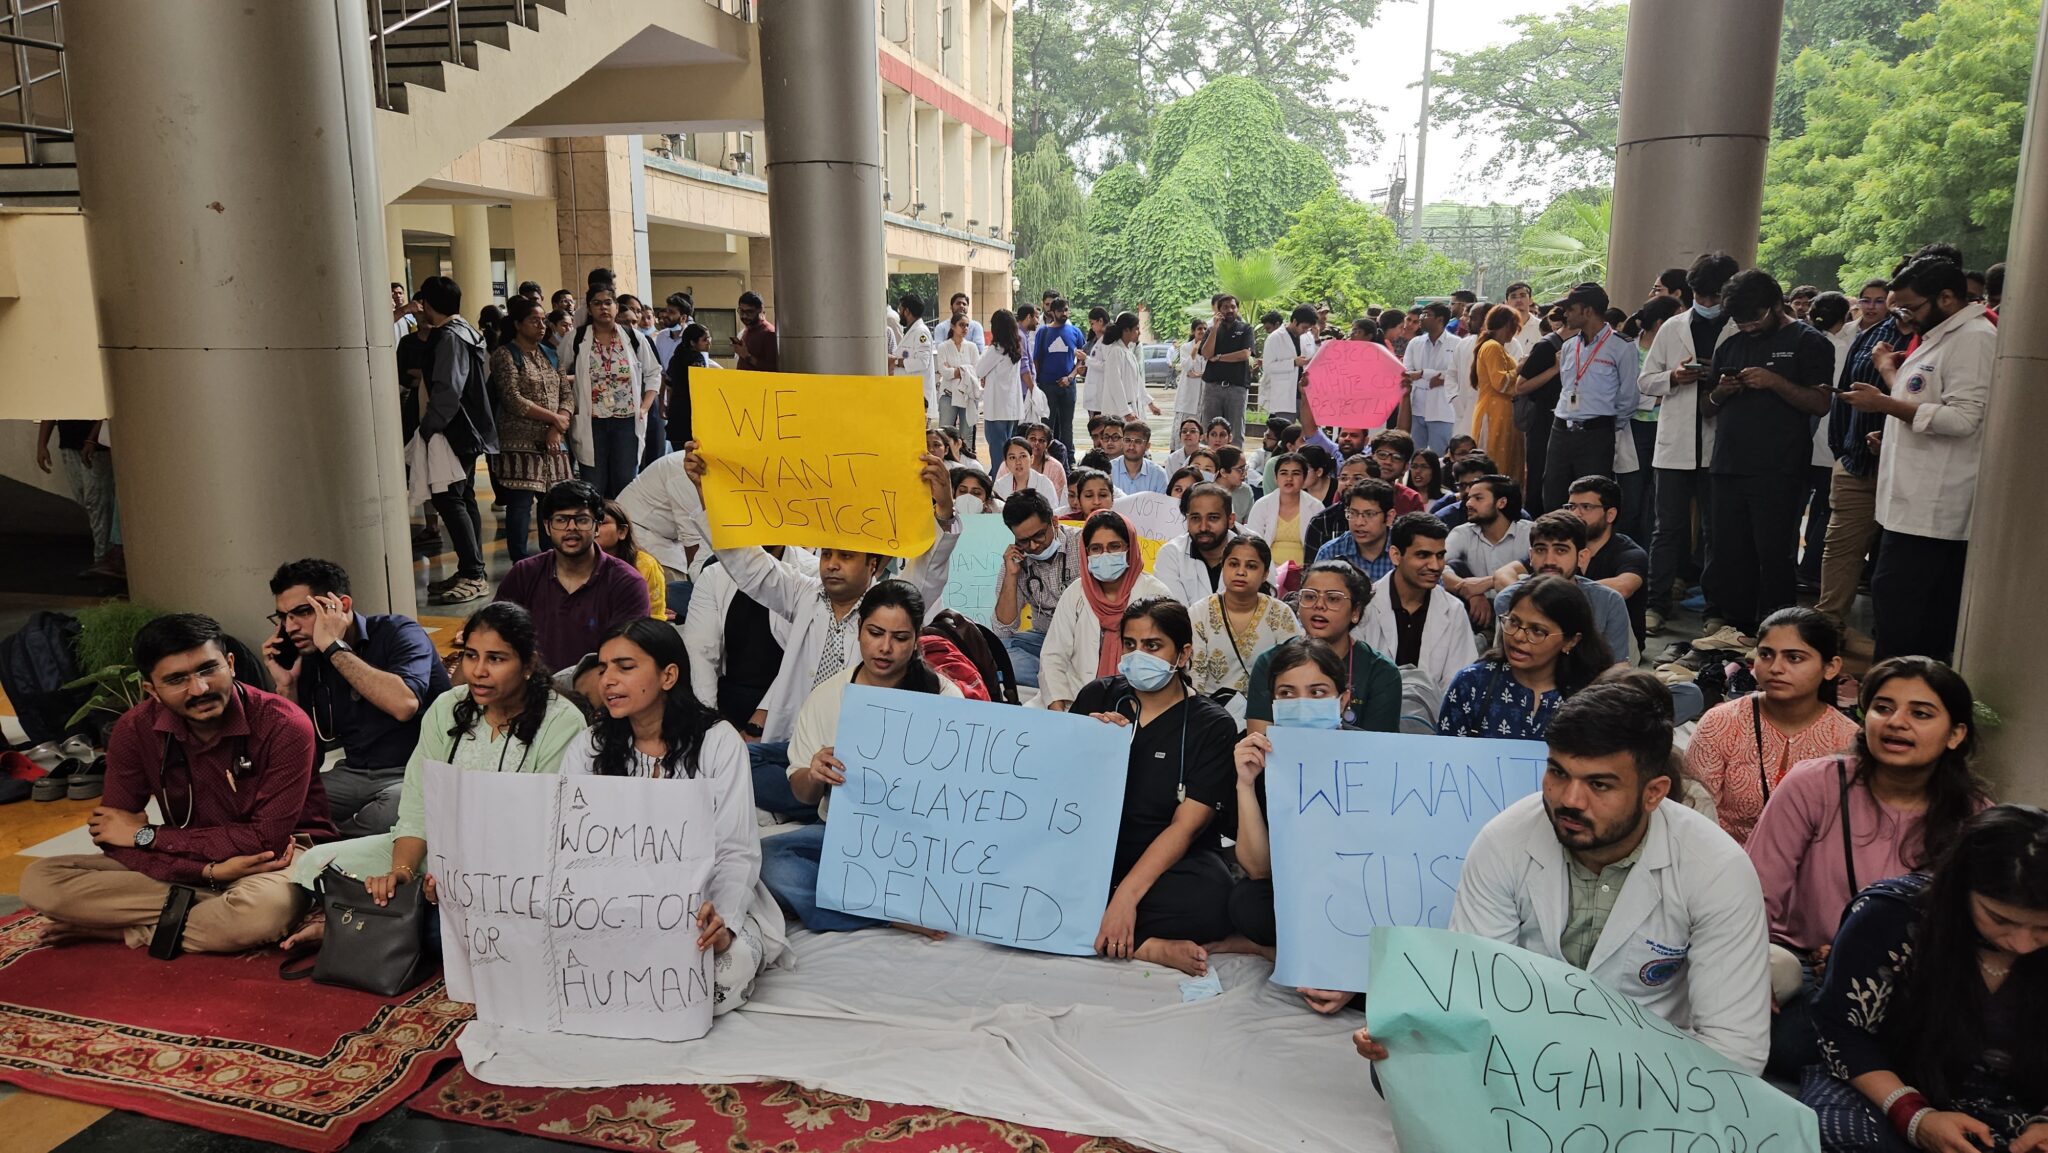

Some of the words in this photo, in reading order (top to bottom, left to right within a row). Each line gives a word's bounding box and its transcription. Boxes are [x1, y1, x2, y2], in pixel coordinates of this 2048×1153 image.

[1313, 374, 1364, 395] WHITE
[1319, 361, 1348, 376] THE
[718, 387, 801, 441] WE
[1311, 397, 1374, 417] RESPECT
[717, 452, 879, 490] WANT
[721, 489, 900, 549] JUSTICE!
[1130, 497, 1164, 518] NOT
[856, 704, 1038, 780] JUSTICE
[573, 786, 588, 807] A
[862, 767, 1028, 823] DELAYED
[1048, 798, 1082, 834] IS
[1298, 759, 1370, 817] WE
[1391, 756, 1547, 822] WANT
[561, 812, 688, 864] WOMAN
[842, 812, 1001, 874] JUSTICE
[436, 854, 545, 920] JUSTICE
[842, 861, 1063, 943] DENIED
[562, 950, 708, 1012] HUMAN
[567, 948, 588, 968] A
[1403, 948, 1702, 1043] VIOLENC
[1483, 1034, 1758, 1118] AGAINST
